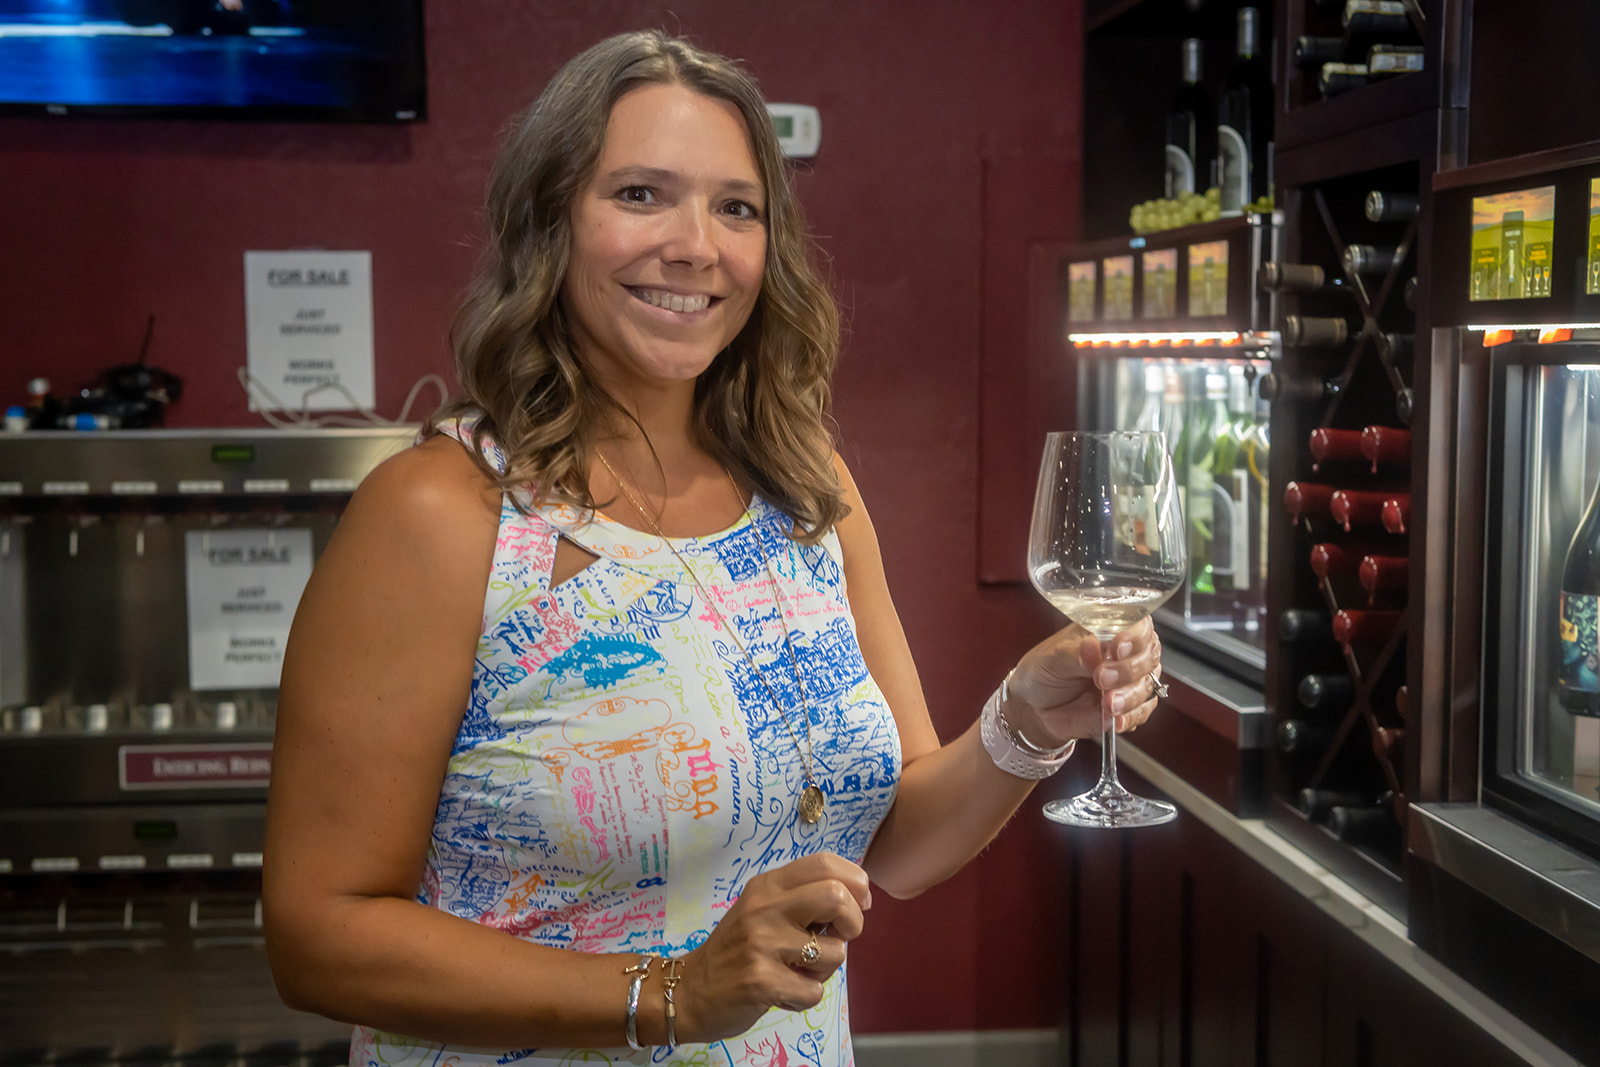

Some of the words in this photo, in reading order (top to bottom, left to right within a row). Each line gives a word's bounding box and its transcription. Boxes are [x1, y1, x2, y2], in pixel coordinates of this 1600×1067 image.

[267, 269, 302, 285] FOR
[307, 268, 350, 285] SALE
[208, 548, 243, 564] FOR
[248, 546, 292, 564] SALE
